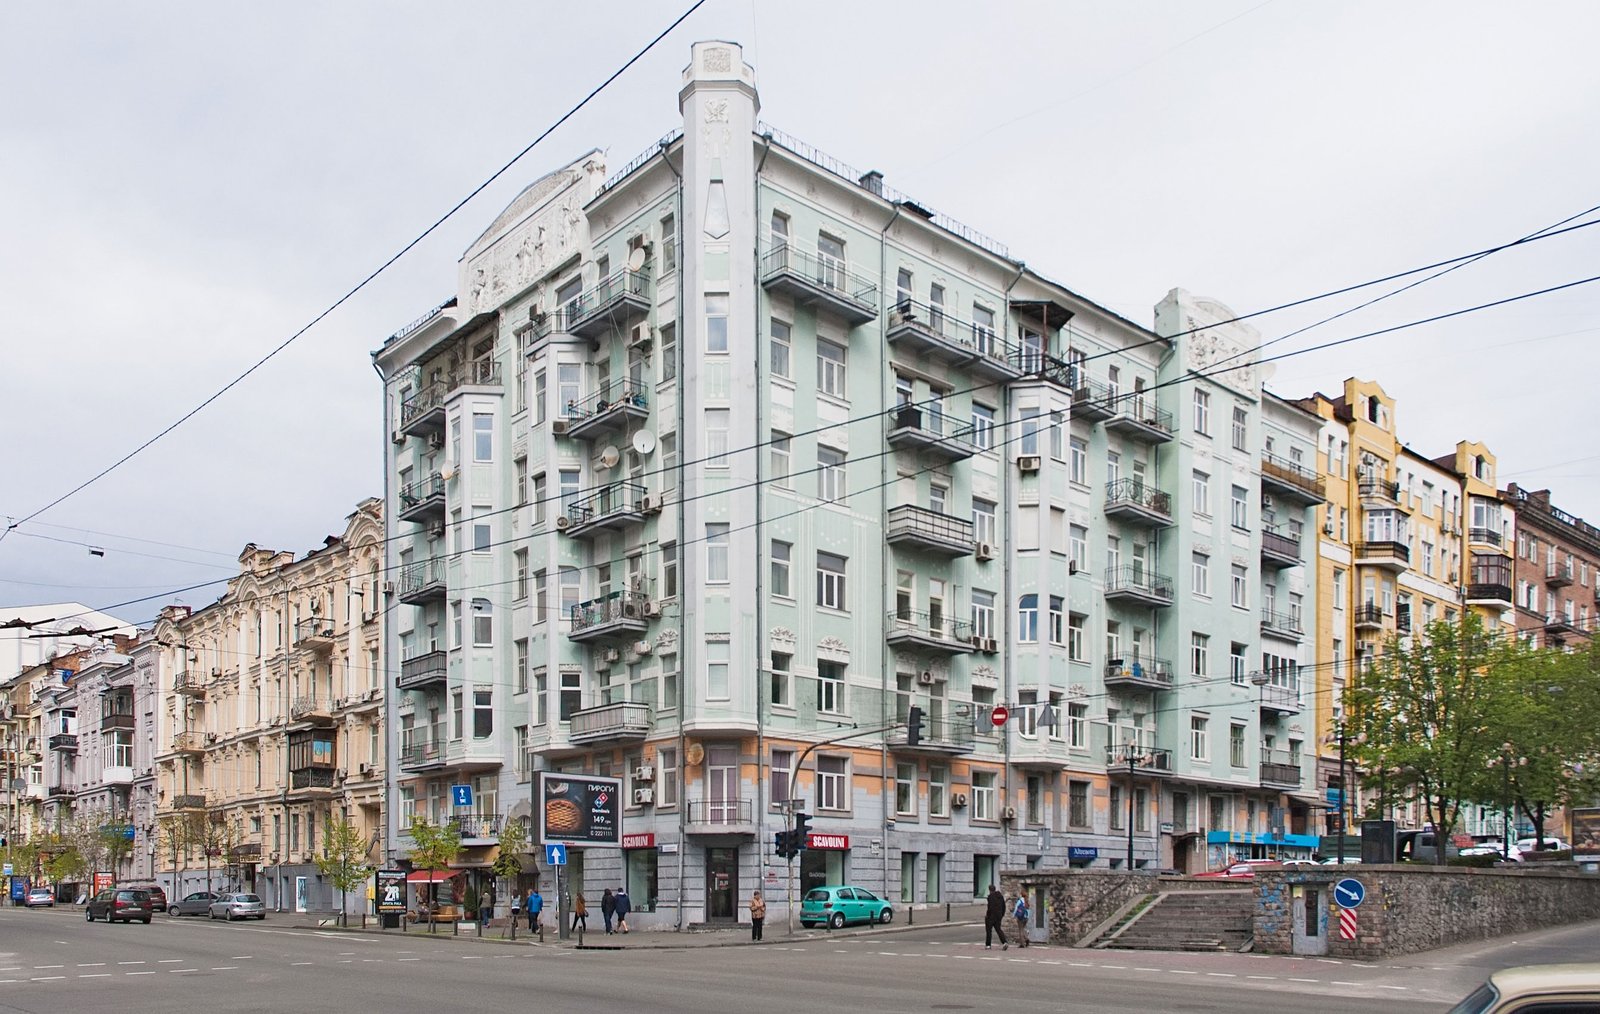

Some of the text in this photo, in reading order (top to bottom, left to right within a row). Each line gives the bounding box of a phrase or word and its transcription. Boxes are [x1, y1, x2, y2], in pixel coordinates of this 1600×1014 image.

[588, 784, 614, 792] ПИРОГИ
[593, 815, 605, 823] 149
[623, 835, 648, 848] SCAVOLINI
[813, 835, 845, 848] SCAVOLINI
